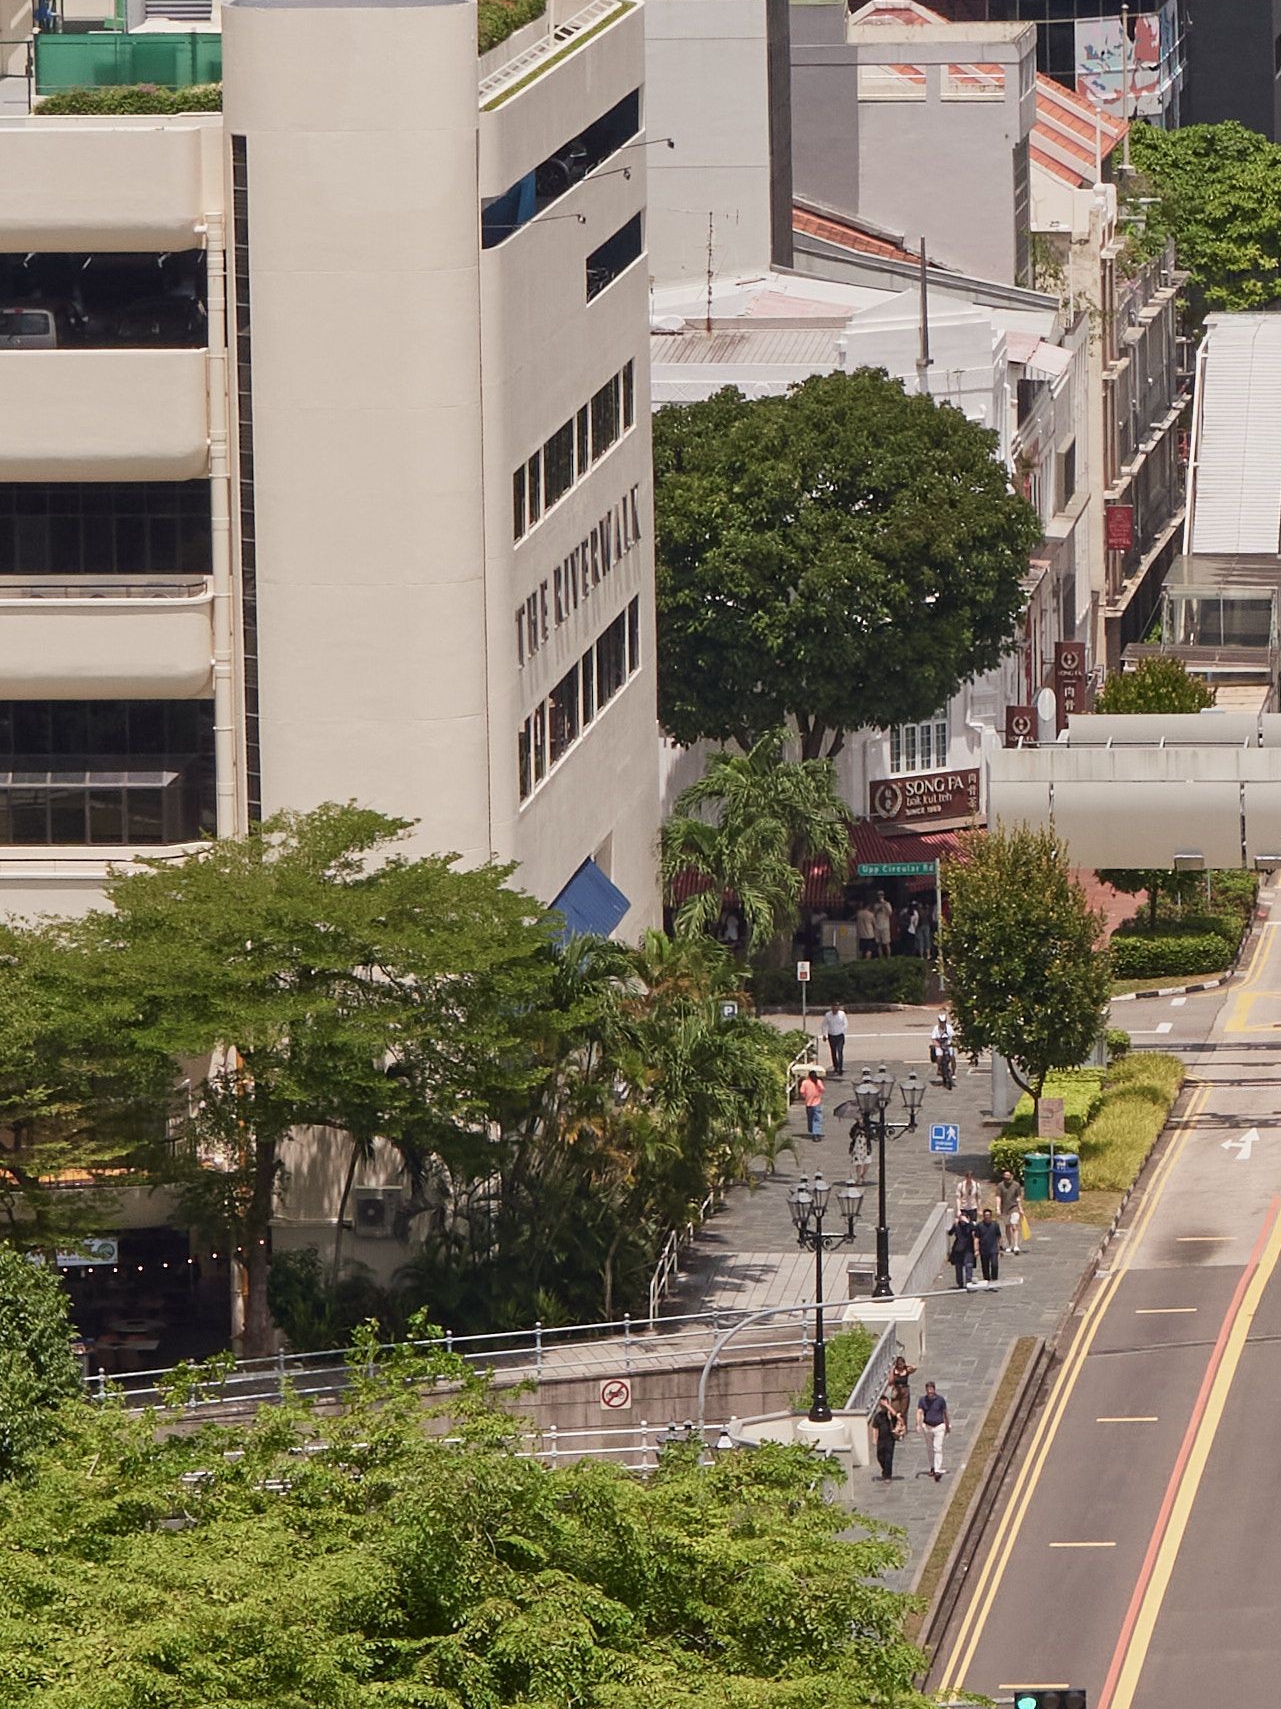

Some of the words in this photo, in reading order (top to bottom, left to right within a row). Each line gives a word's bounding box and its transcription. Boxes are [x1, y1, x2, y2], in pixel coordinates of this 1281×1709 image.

[905, 777, 944, 796] SONG
[947, 775, 964, 791] FA
[862, 865, 880, 874] Upp
[882, 864, 920, 873] Circular
[922, 863, 935, 872] Rd
[724, 1005, 734, 1016] P
